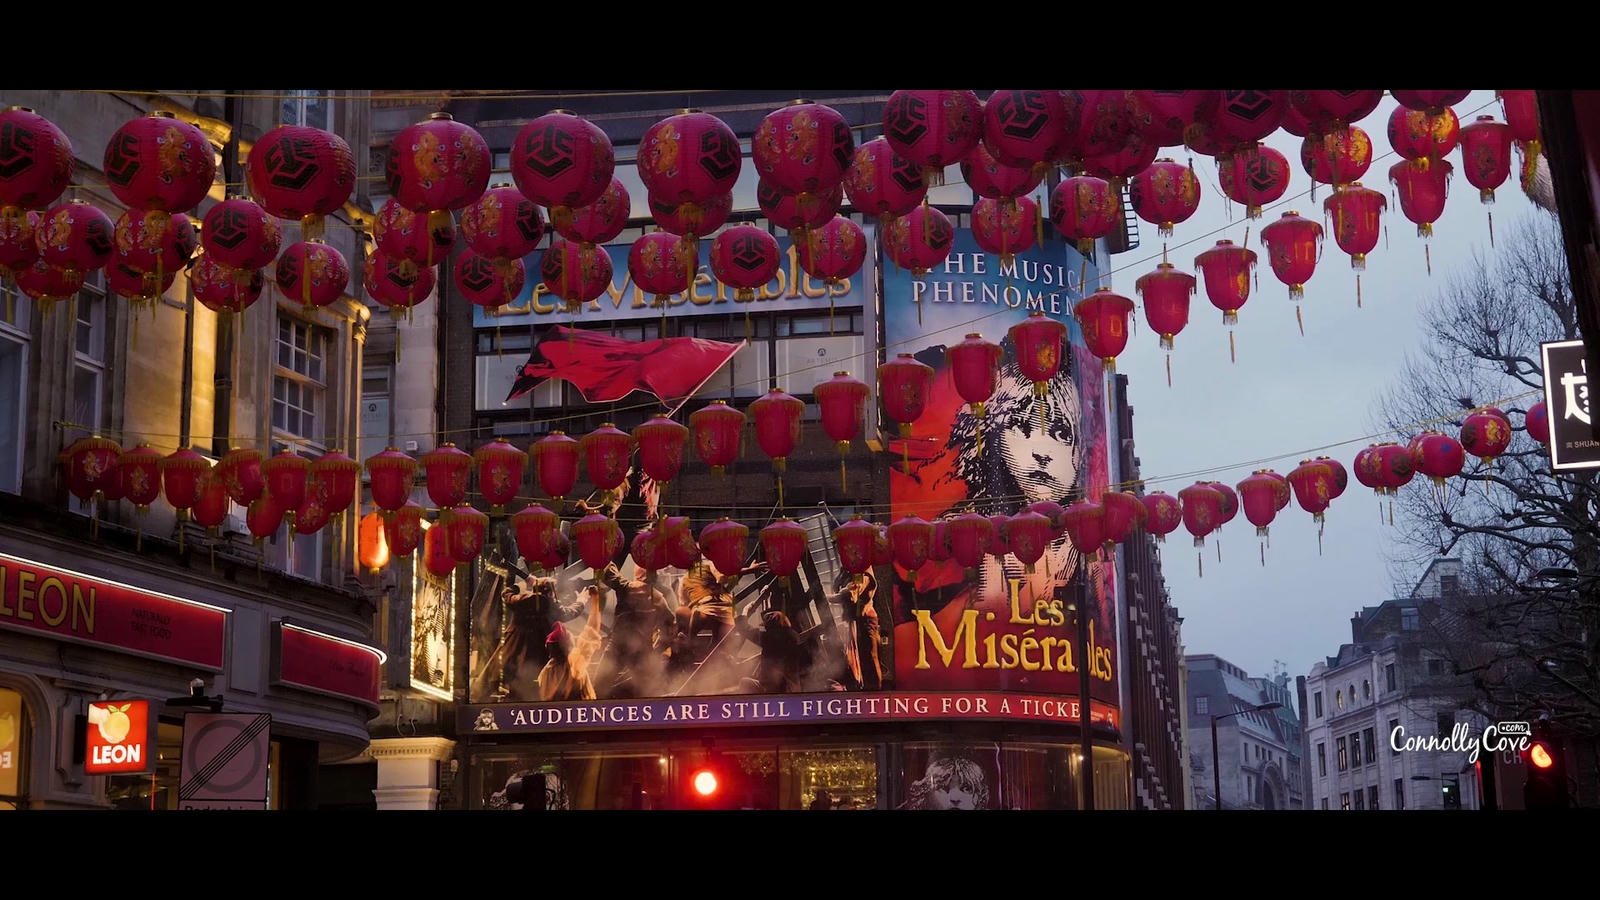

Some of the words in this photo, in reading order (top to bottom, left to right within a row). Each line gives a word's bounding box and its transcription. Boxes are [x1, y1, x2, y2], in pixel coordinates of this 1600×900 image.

[911, 281, 1075, 317] PHENOMEN
[0, 565, 97, 635] LEON
[1009, 579, 1064, 626] Les
[664, 703, 710, 722] ARE
[721, 701, 791, 719] STILL
[802, 697, 929, 717] FIGHTING
[941, 697, 990, 714] FOR
[1000, 698, 1011, 714] A
[1020, 699, 1081, 718] TICKE
[92, 743, 141, 764] LEON
